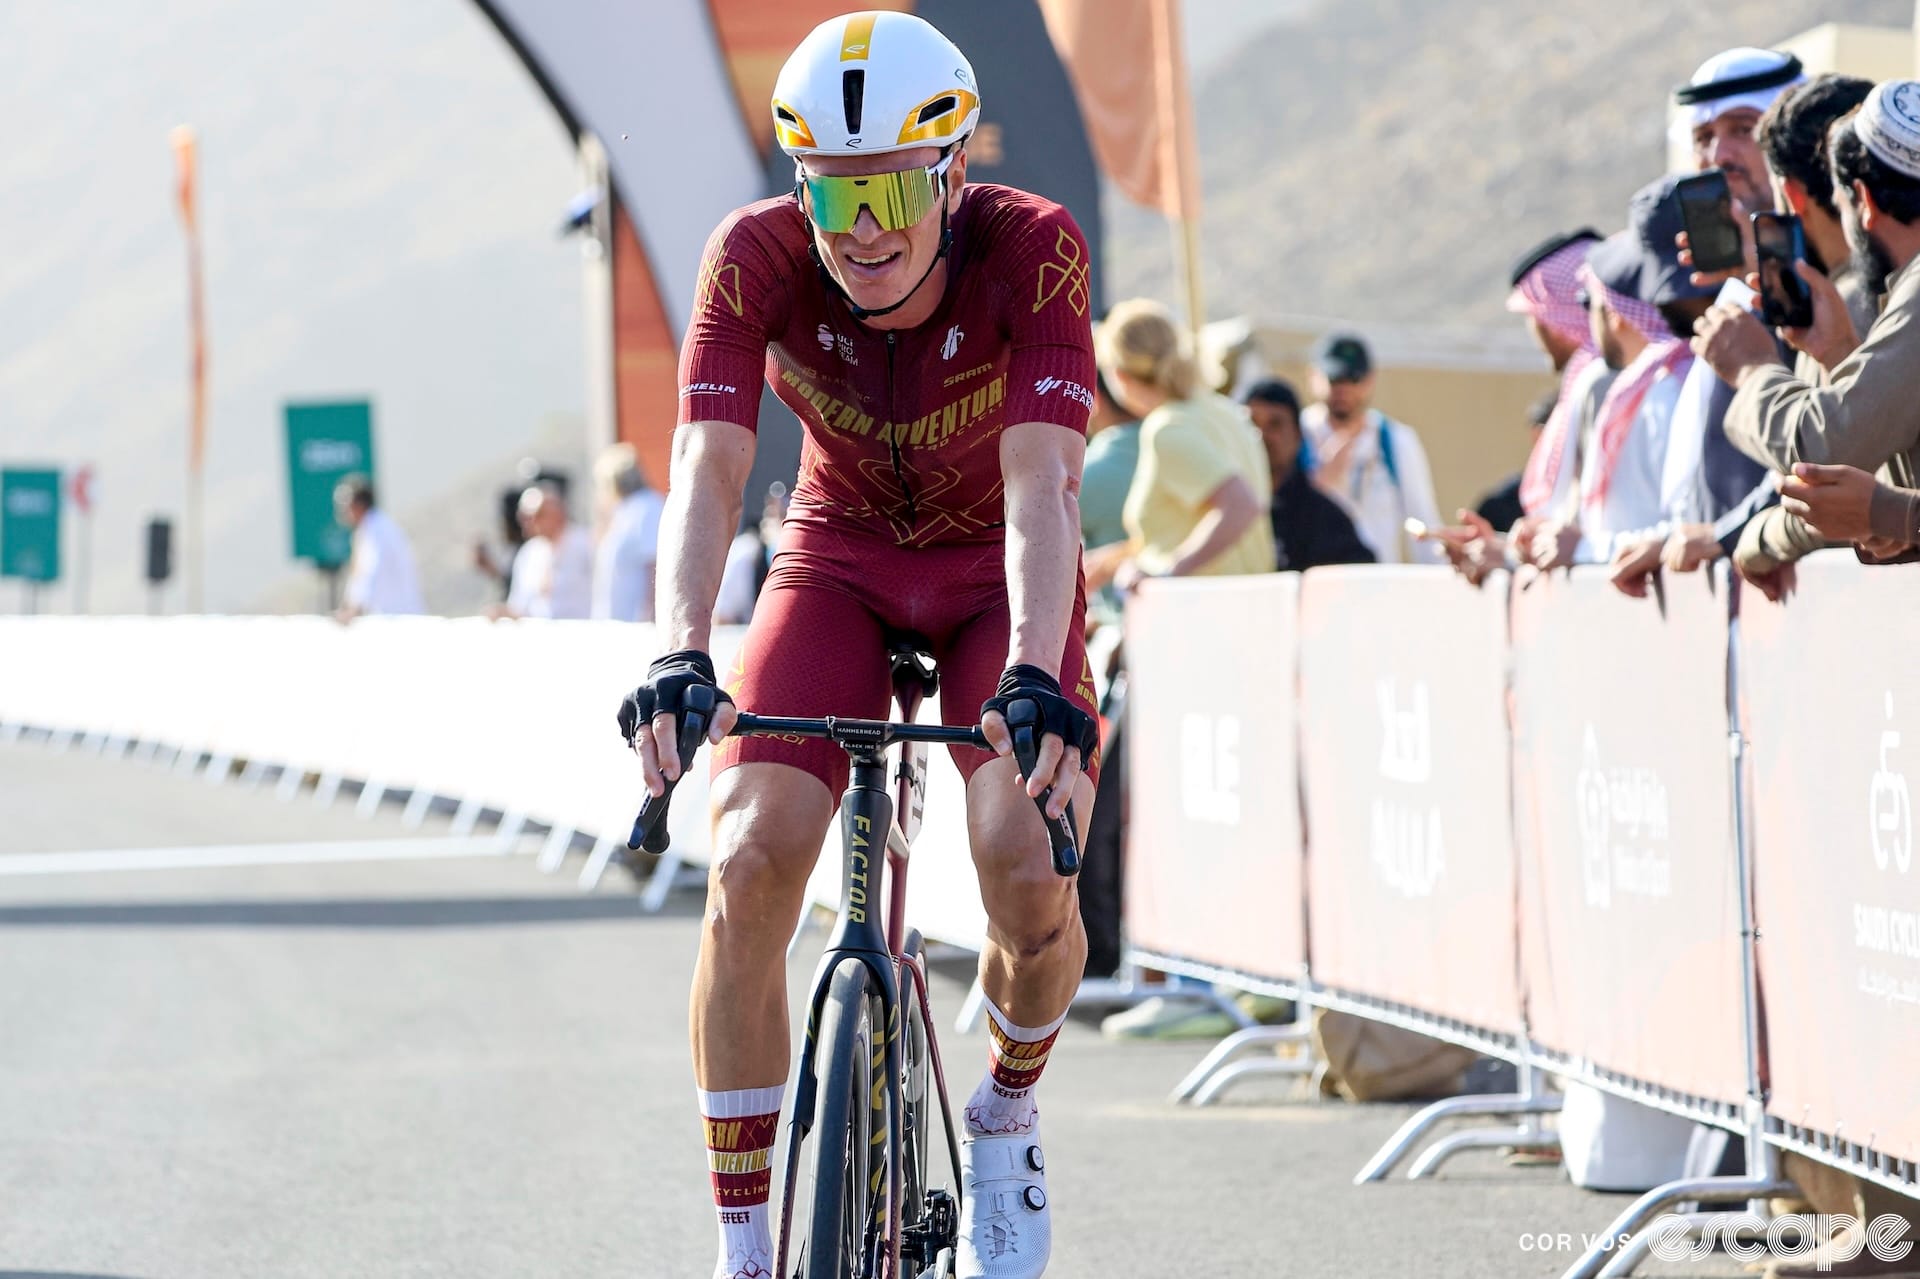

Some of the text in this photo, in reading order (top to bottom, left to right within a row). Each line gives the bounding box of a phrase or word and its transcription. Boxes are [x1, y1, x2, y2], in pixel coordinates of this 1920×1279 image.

[837, 334, 853, 347] UCI
[838, 342, 853, 356] PRO
[943, 362, 993, 388] SRAM
[680, 383, 737, 394] CHELIN
[781, 370, 1007, 447] MODERN ADVENTUR
[849, 814, 872, 924] FACTOR
